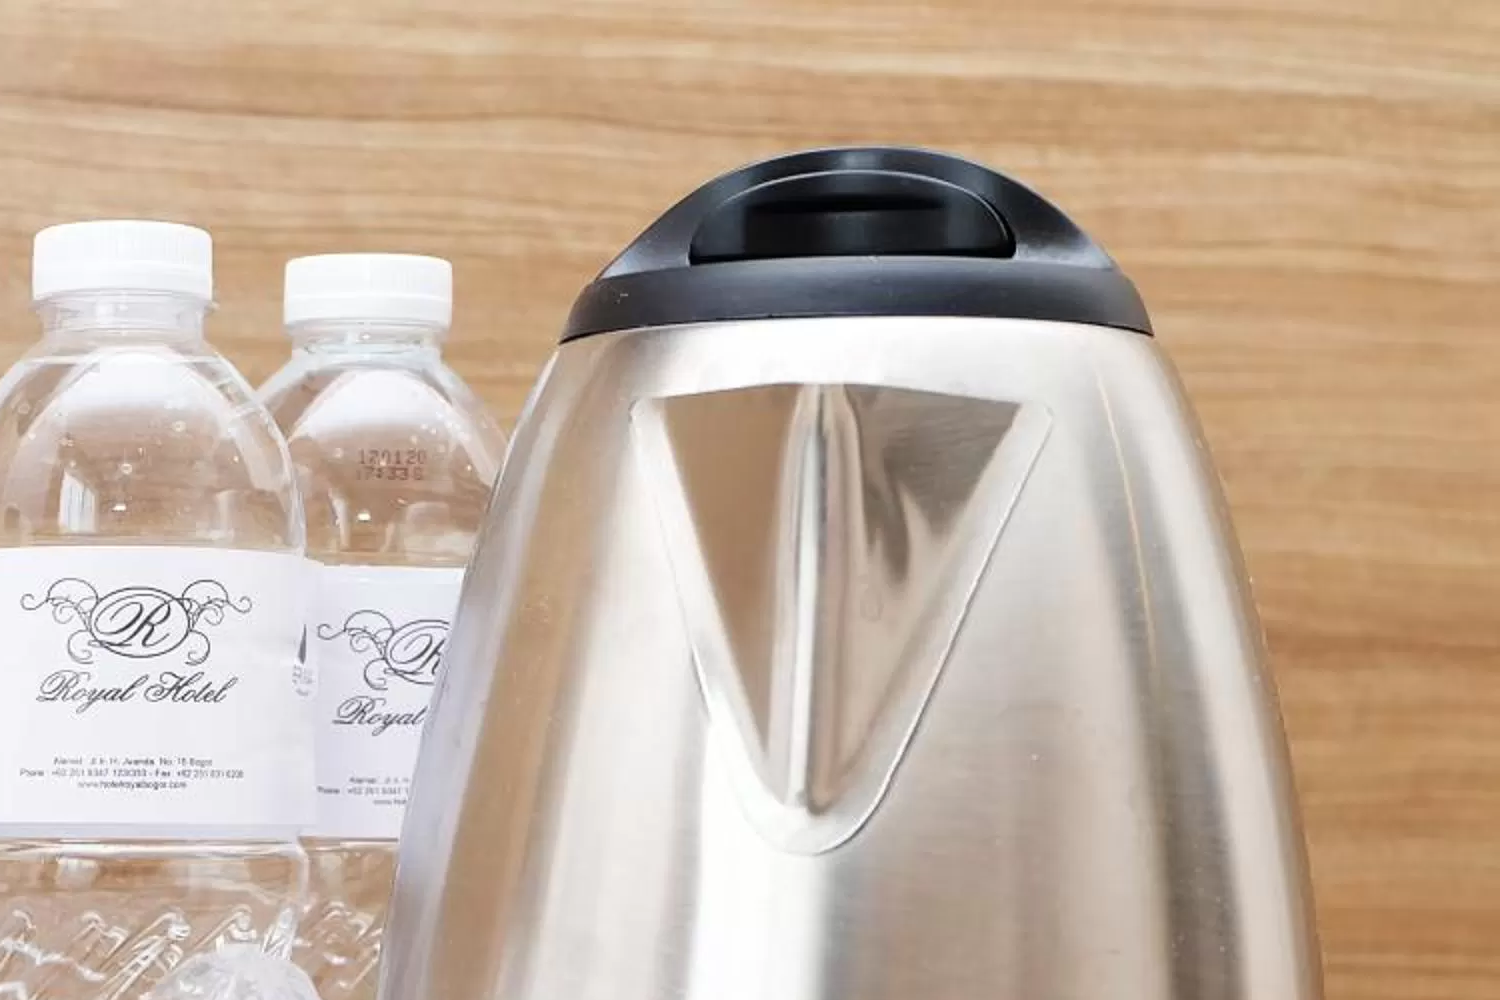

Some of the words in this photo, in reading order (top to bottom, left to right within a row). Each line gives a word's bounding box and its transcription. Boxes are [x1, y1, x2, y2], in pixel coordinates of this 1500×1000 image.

[36, 669, 149, 714] Royal
[145, 671, 238, 702] Hotel
[332, 695, 426, 736] Royal
